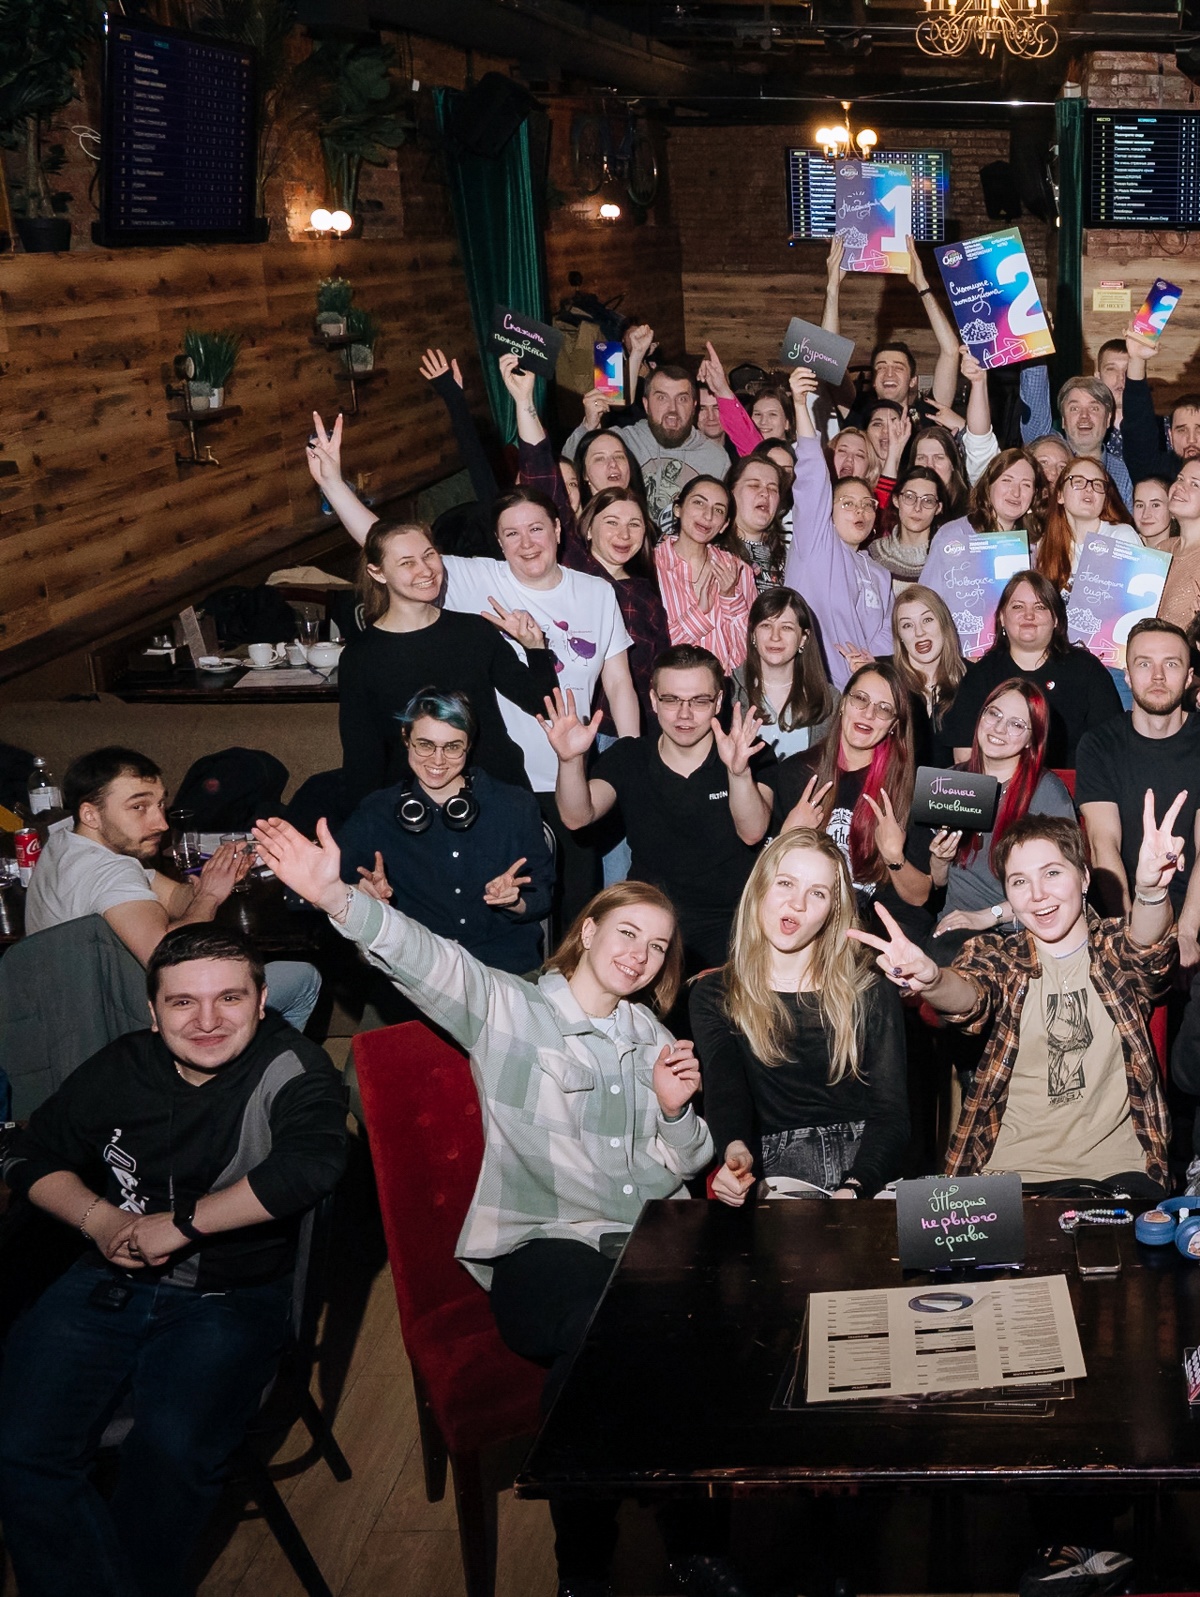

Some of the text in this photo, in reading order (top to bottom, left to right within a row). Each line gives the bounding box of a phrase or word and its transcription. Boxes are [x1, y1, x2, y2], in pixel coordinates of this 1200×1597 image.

[880, 185, 911, 252] 1
[996, 252, 1048, 337] 2
[1148, 295, 1179, 331] 2
[606, 352, 624, 387] 1
[1112, 573, 1166, 646] 2
[928, 1184, 986, 1216] Теория
[921, 1211, 998, 1235] нервного
